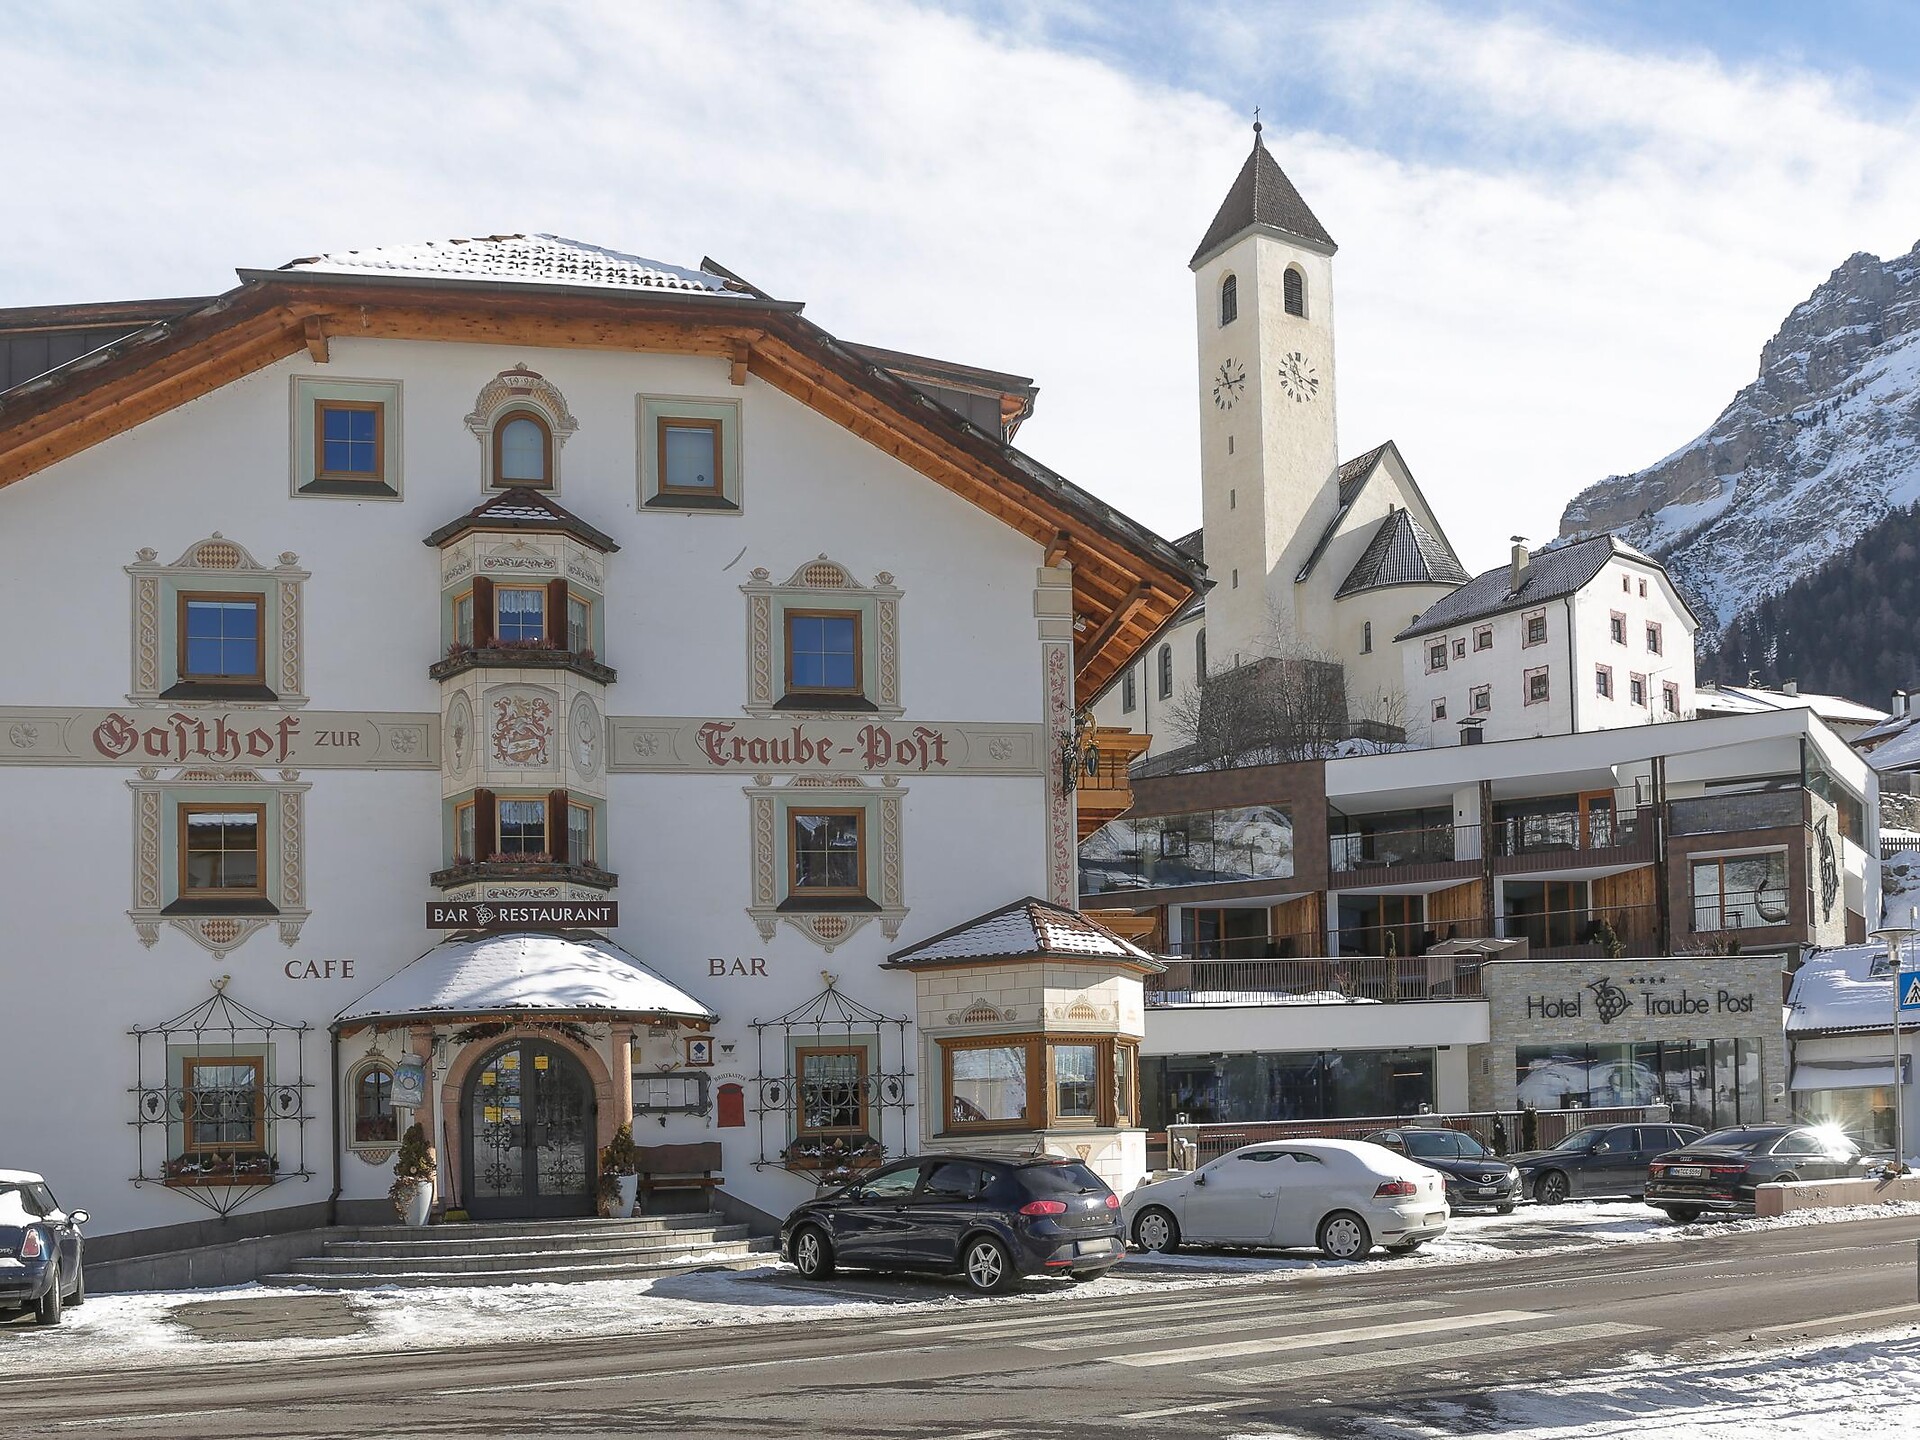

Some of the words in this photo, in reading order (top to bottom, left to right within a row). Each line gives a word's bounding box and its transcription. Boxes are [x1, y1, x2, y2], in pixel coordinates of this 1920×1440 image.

[314, 730, 361, 747] ZUR
[434, 908, 469, 922] BAR
[499, 907, 611, 922] RESTAURANT
[284, 959, 356, 979] CAFE
[707, 957, 769, 977] BAR
[1527, 992, 1582, 1019] Hotel
[1641, 990, 1709, 1015] Traube
[1717, 990, 1754, 1013] Post
